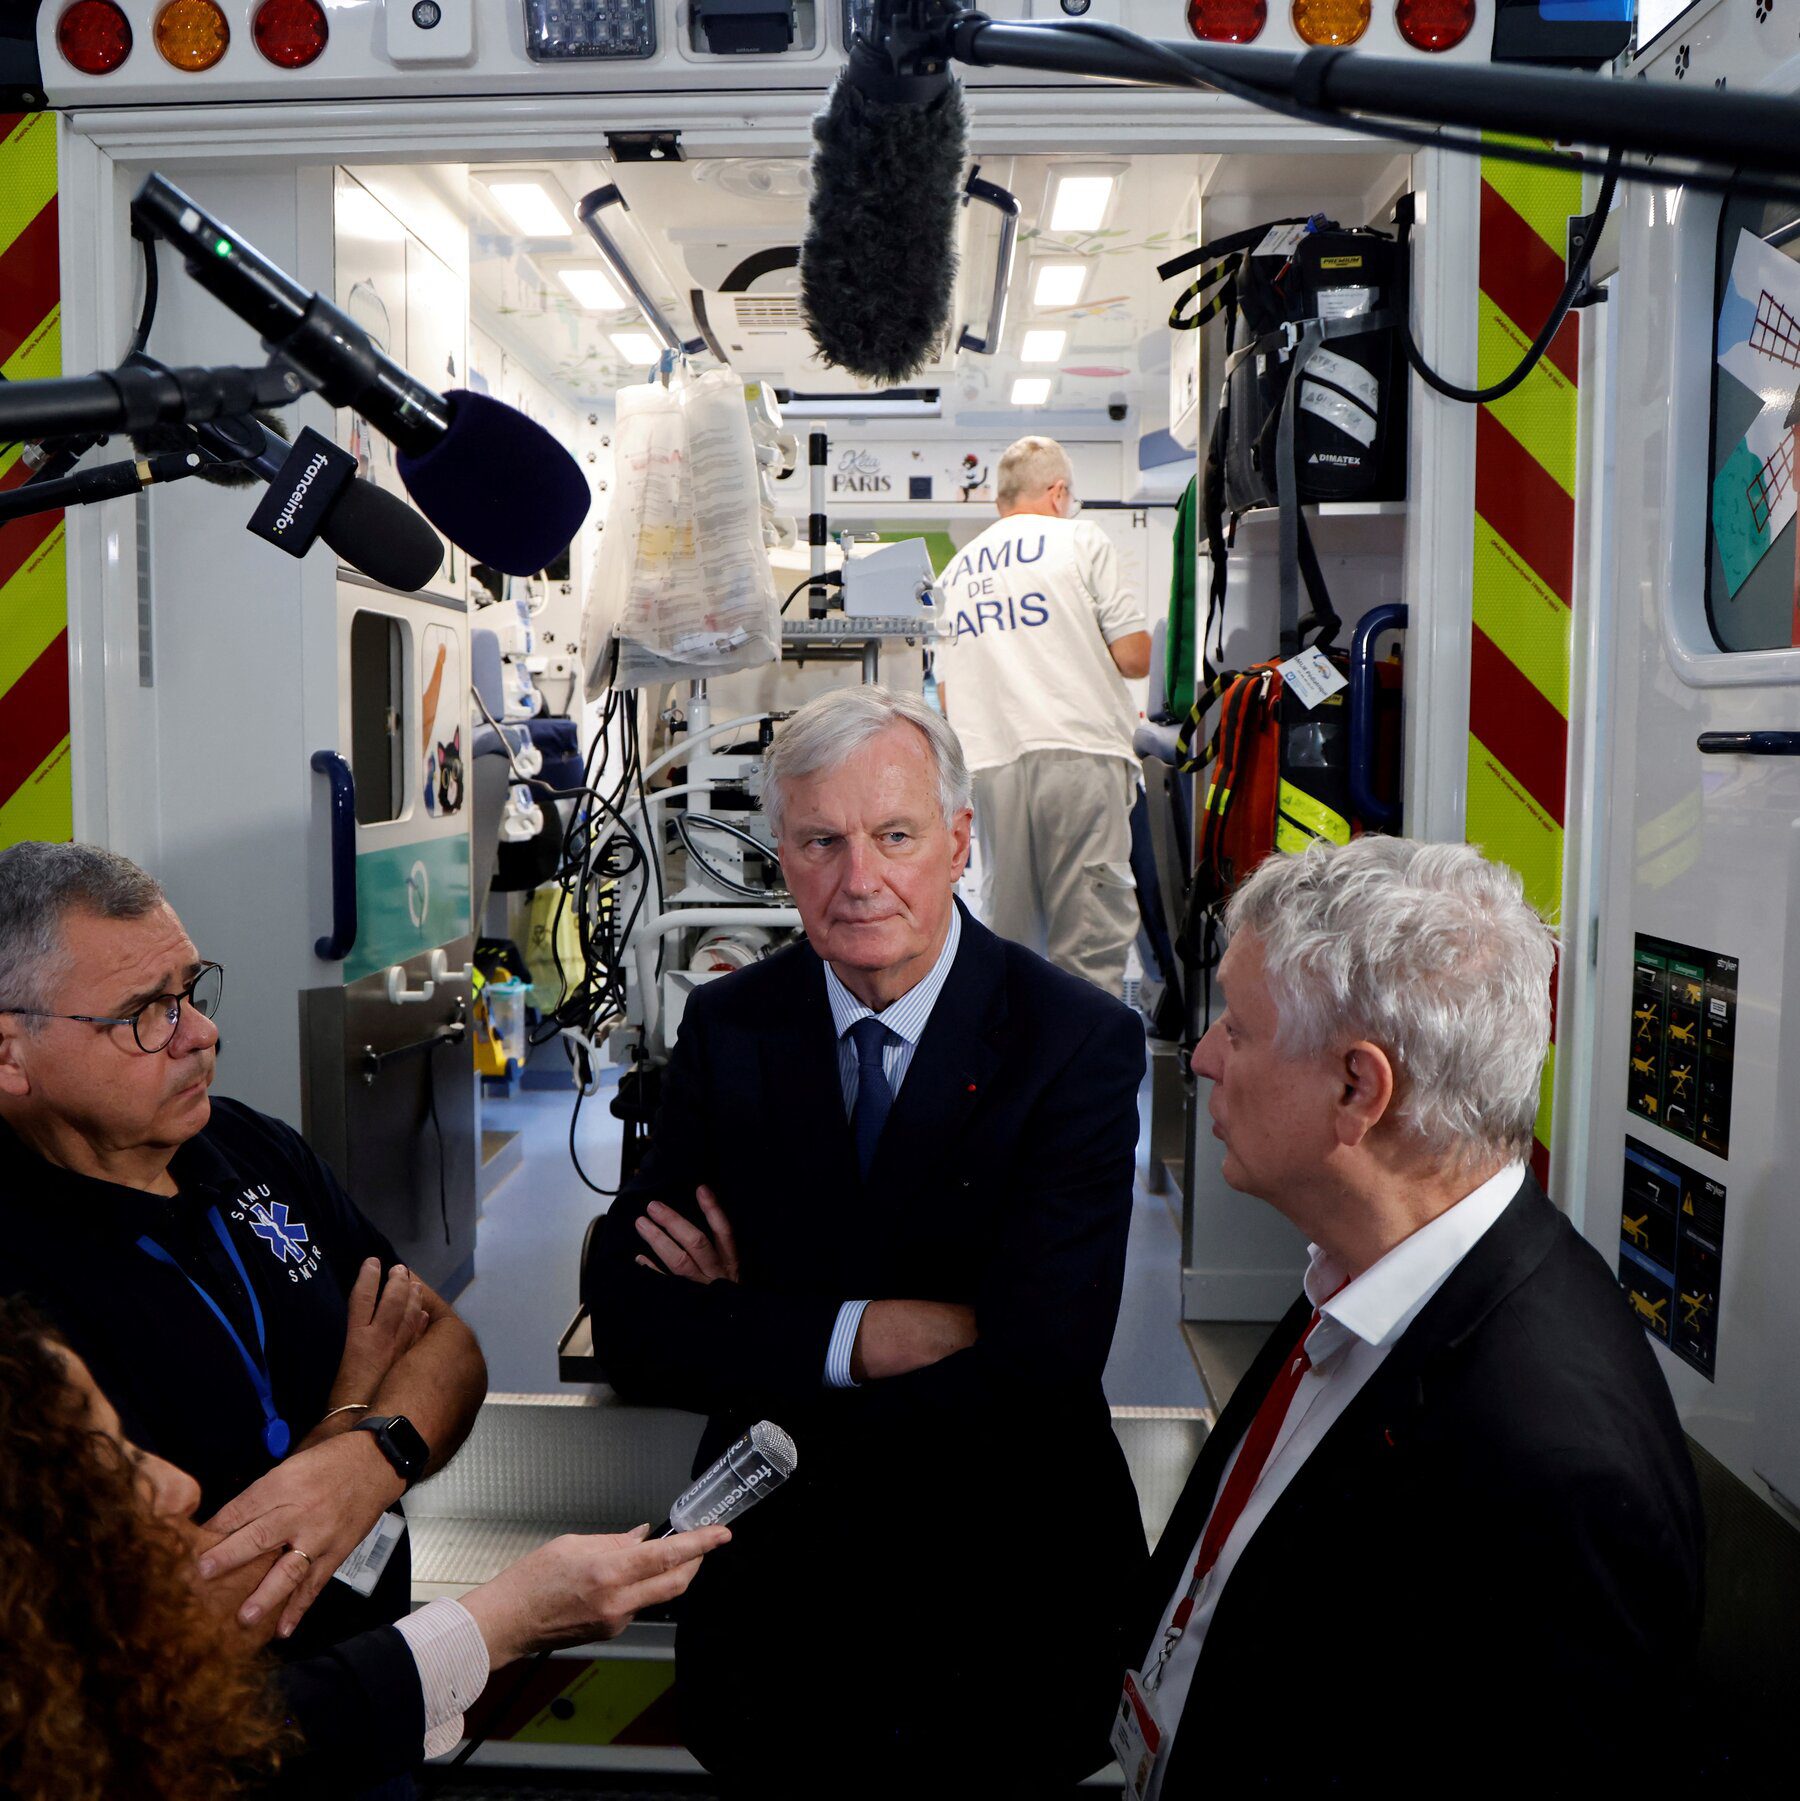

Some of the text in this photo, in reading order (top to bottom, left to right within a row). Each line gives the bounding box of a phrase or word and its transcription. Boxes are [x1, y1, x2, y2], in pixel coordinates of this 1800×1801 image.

[1318, 453, 1361, 465] DIMATEX
[273, 453, 328, 535] franceinfo:
[832, 474, 892, 492] PARIS
[968, 577, 995, 598] DE
[949, 592, 1050, 639] ARIS
[230, 1184, 271, 1221] SAMU
[288, 1245, 322, 1283] SMUR
